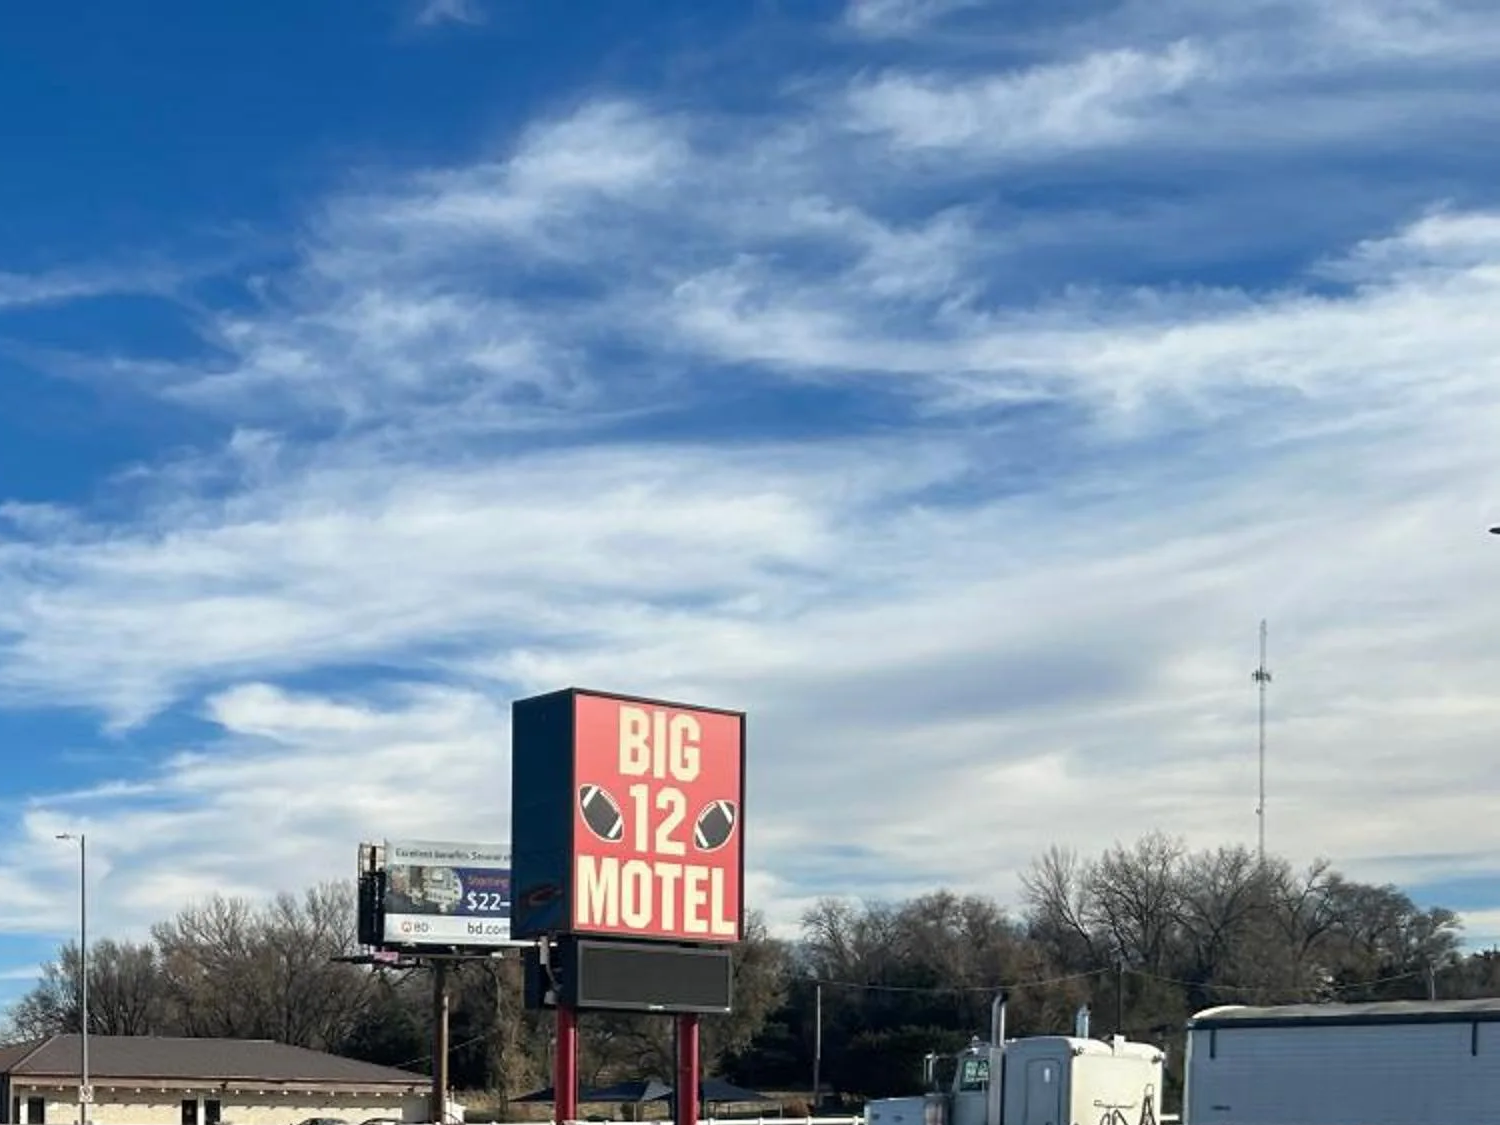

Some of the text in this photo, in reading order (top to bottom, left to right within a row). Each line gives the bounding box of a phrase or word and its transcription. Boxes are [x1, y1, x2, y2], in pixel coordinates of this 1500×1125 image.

[618, 705, 701, 782] BIG
[629, 783, 687, 856] 12
[577, 855, 736, 935] MOTEL
